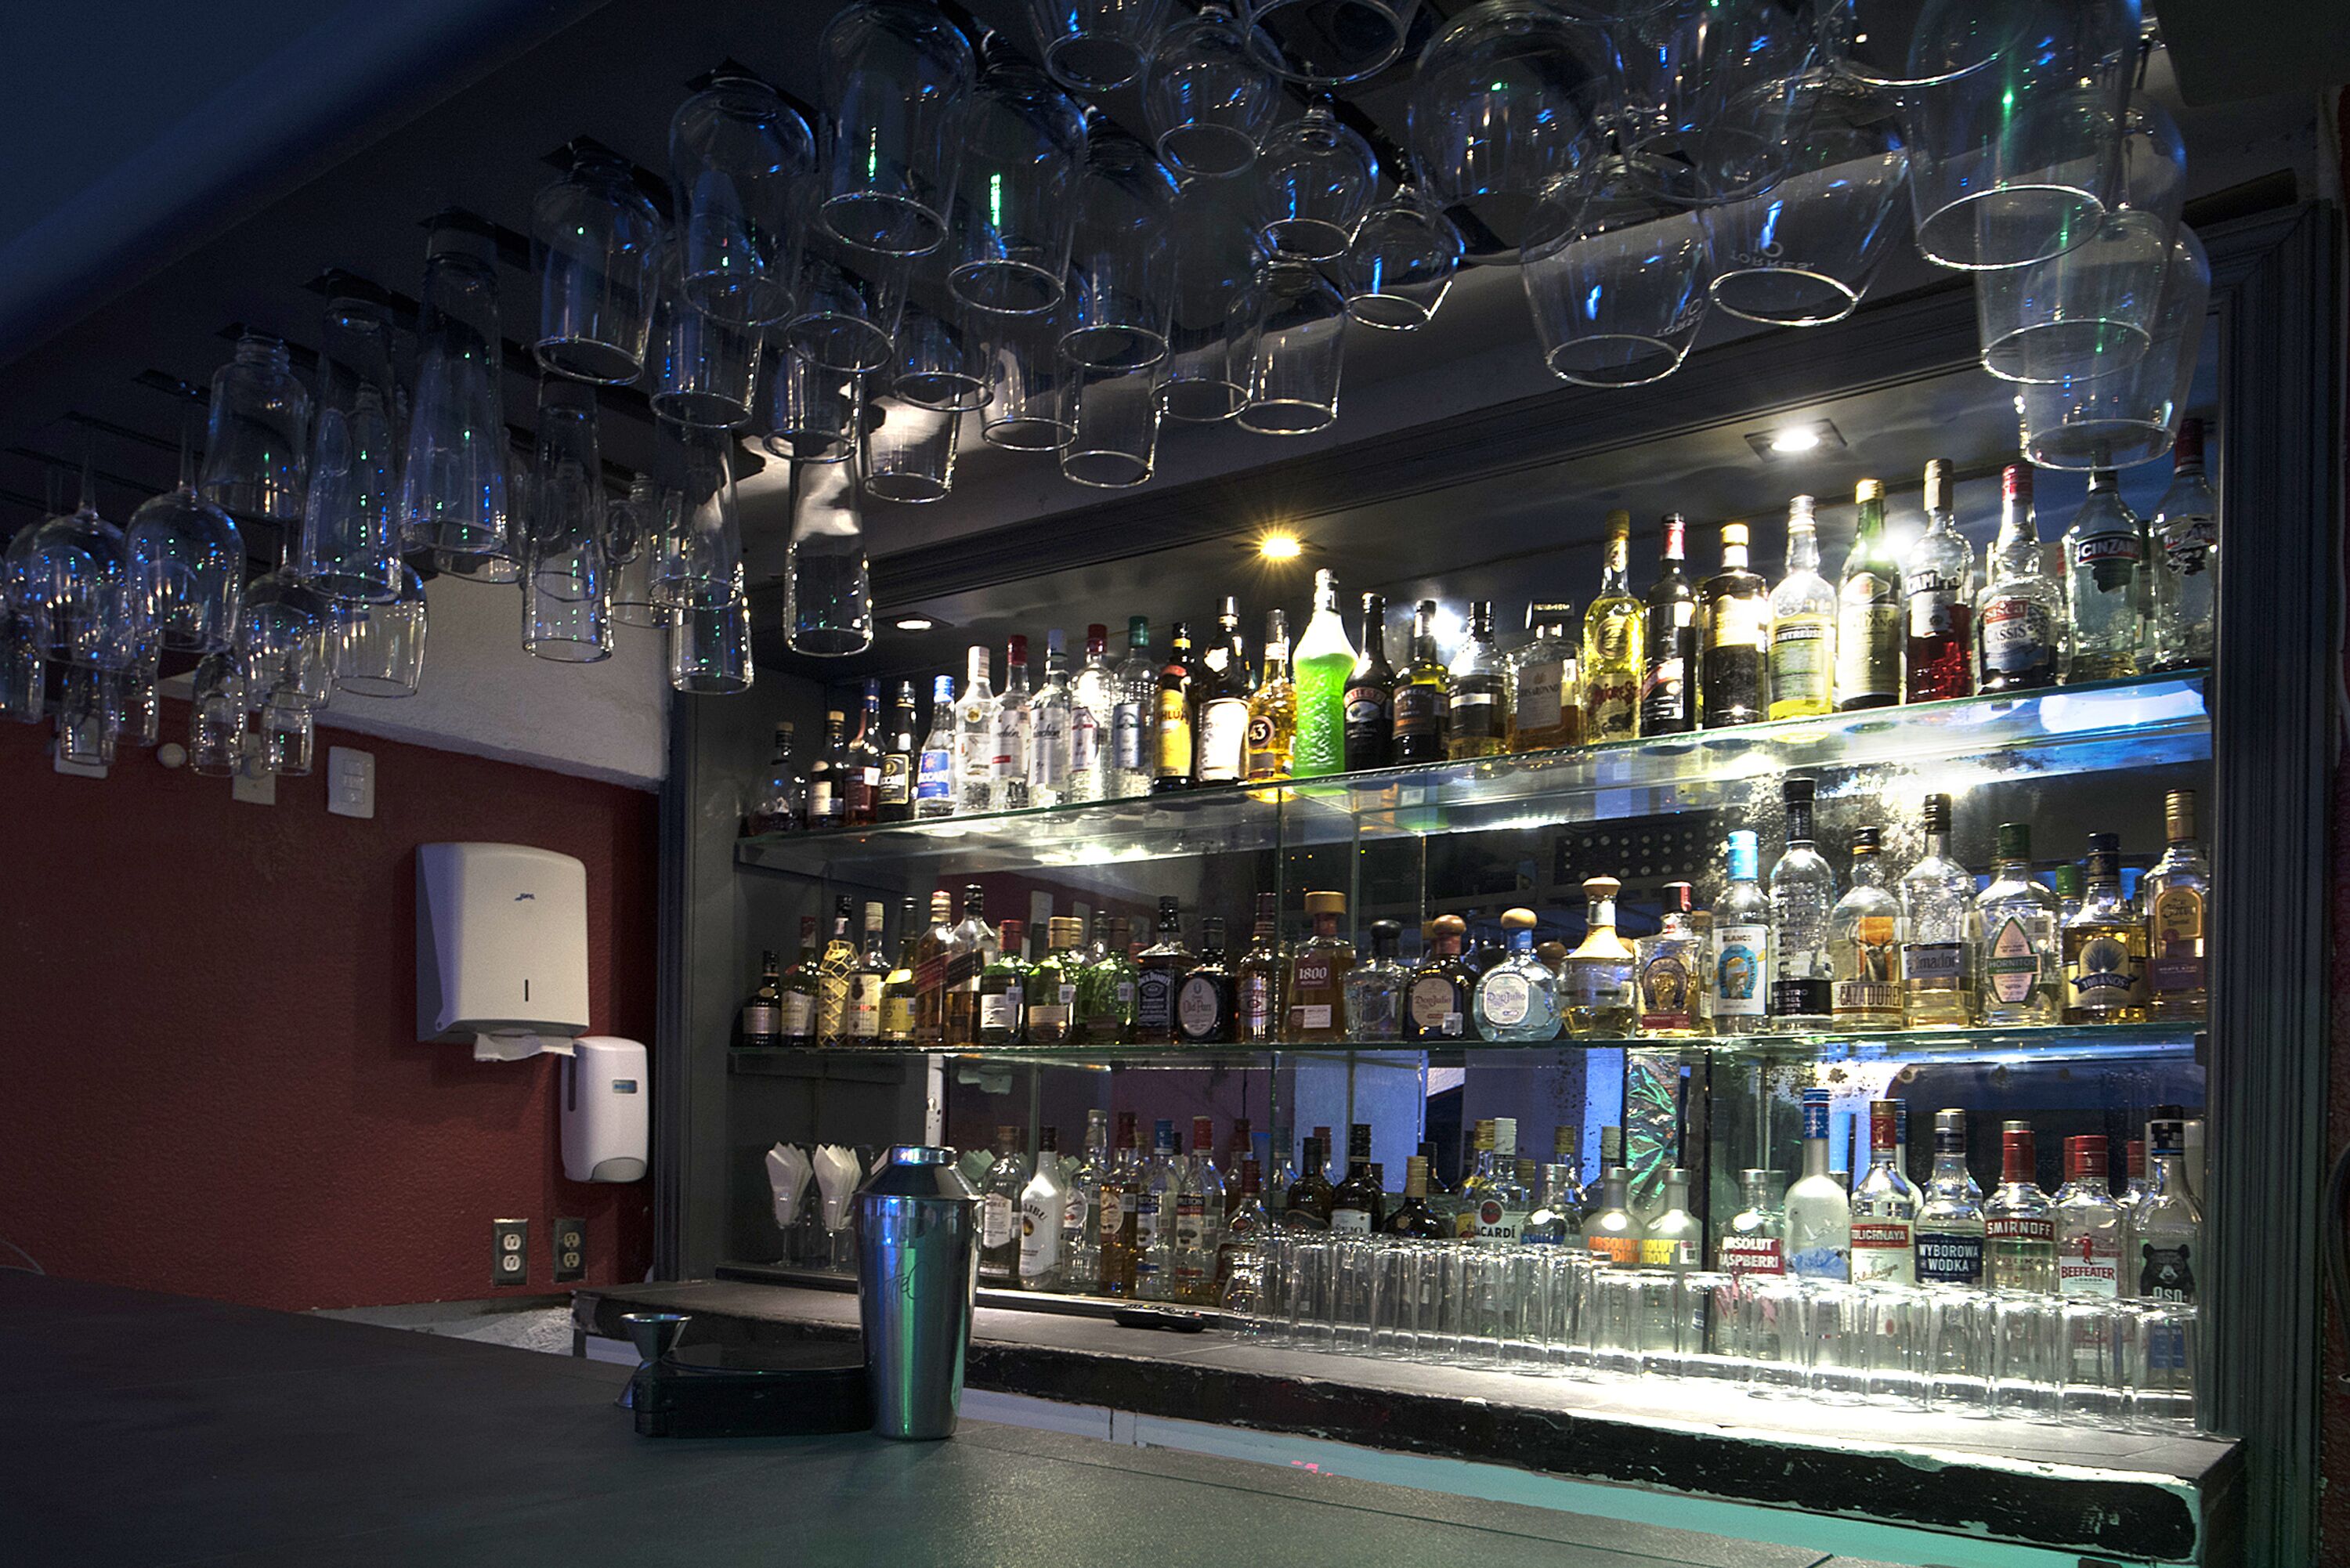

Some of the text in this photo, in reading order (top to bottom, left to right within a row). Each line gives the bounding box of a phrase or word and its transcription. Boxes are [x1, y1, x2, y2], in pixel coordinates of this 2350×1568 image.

[1249, 723, 1266, 741] 43
[1723, 934, 1752, 942] BLANCO
[1989, 957, 2037, 968] HORNITOS
[1299, 966, 1328, 980] 1800
[2083, 977, 2099, 989] 100
[1987, 1220, 2052, 1237] SMIRNOFF
[1722, 1236, 1776, 1251] ABSOLUT
[1918, 1244, 1979, 1258] WYBOROWA
[1928, 1258, 1969, 1273] WODKA
[2061, 1266, 2116, 1281] BEEFEATER
